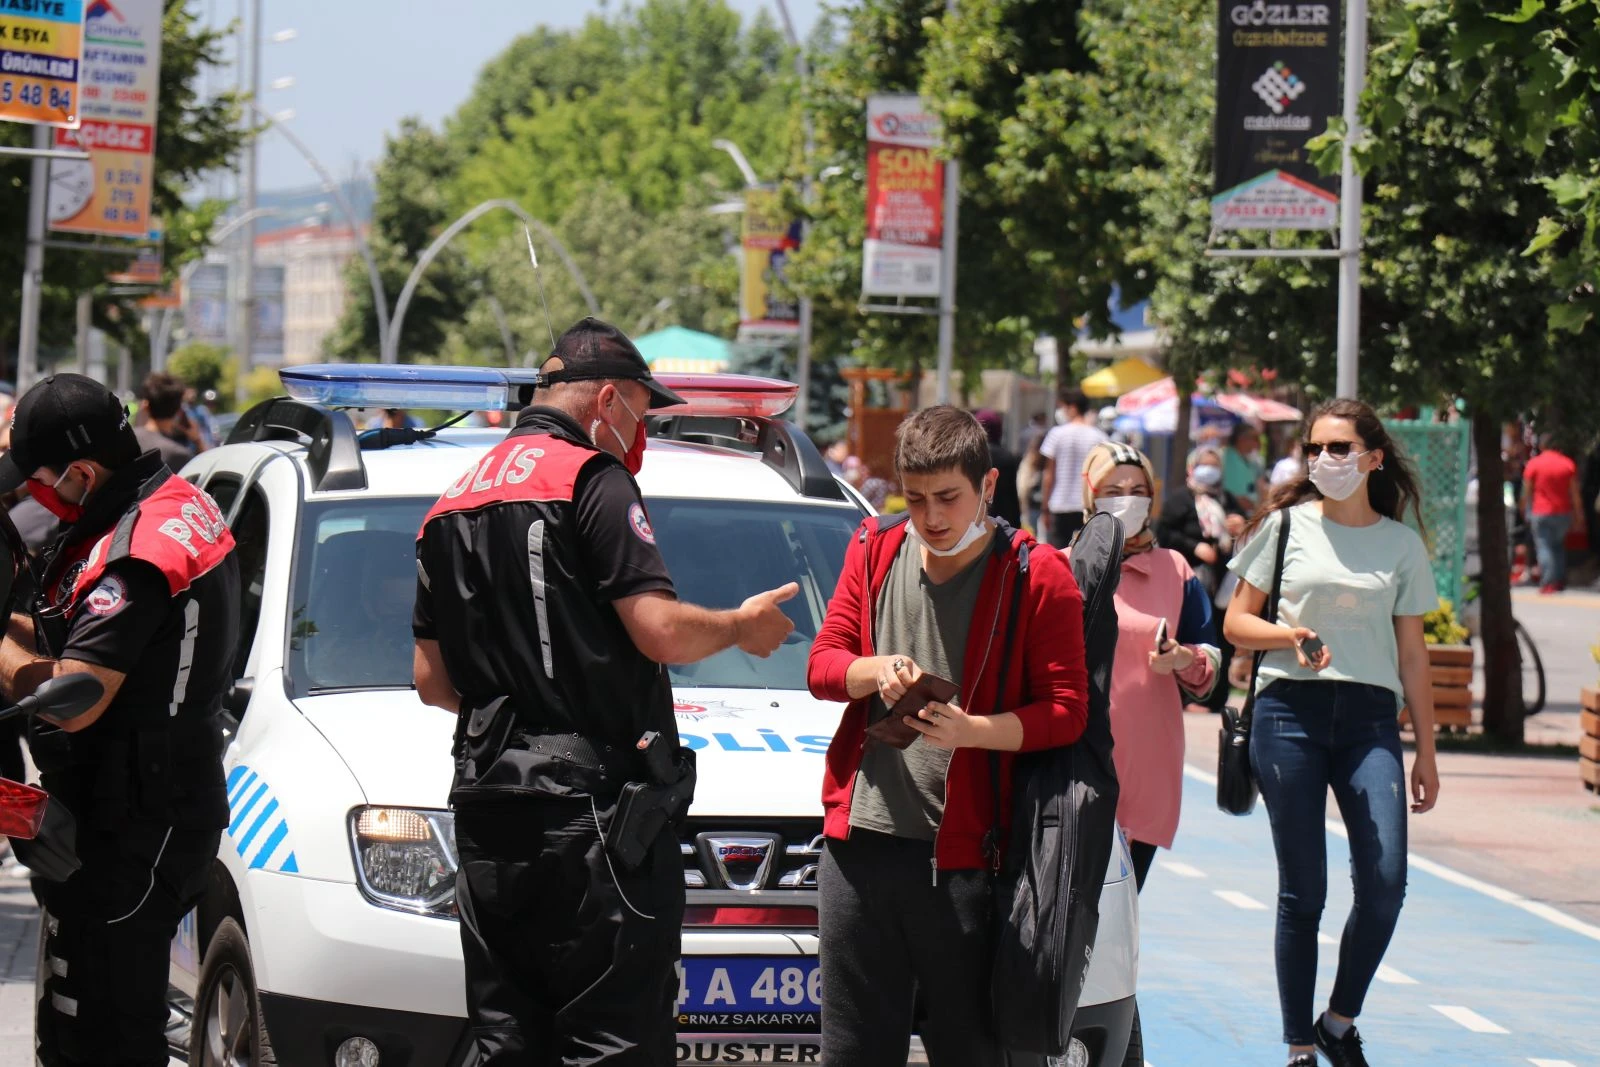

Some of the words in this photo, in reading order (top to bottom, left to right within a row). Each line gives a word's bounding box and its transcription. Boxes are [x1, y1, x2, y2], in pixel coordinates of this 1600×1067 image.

[1230, 0, 1330, 26] GÖZLER
[13, 26, 49, 44] EŞYA
[1, 51, 75, 79] ÜRÜNLERİ
[20, 84, 42, 107] 48
[50, 86, 71, 109] 84
[877, 148, 936, 175] SON
[703, 967, 737, 1005] A
[732, 1013, 816, 1025] SAKARYA
[675, 1042, 822, 1063] DUSTER
